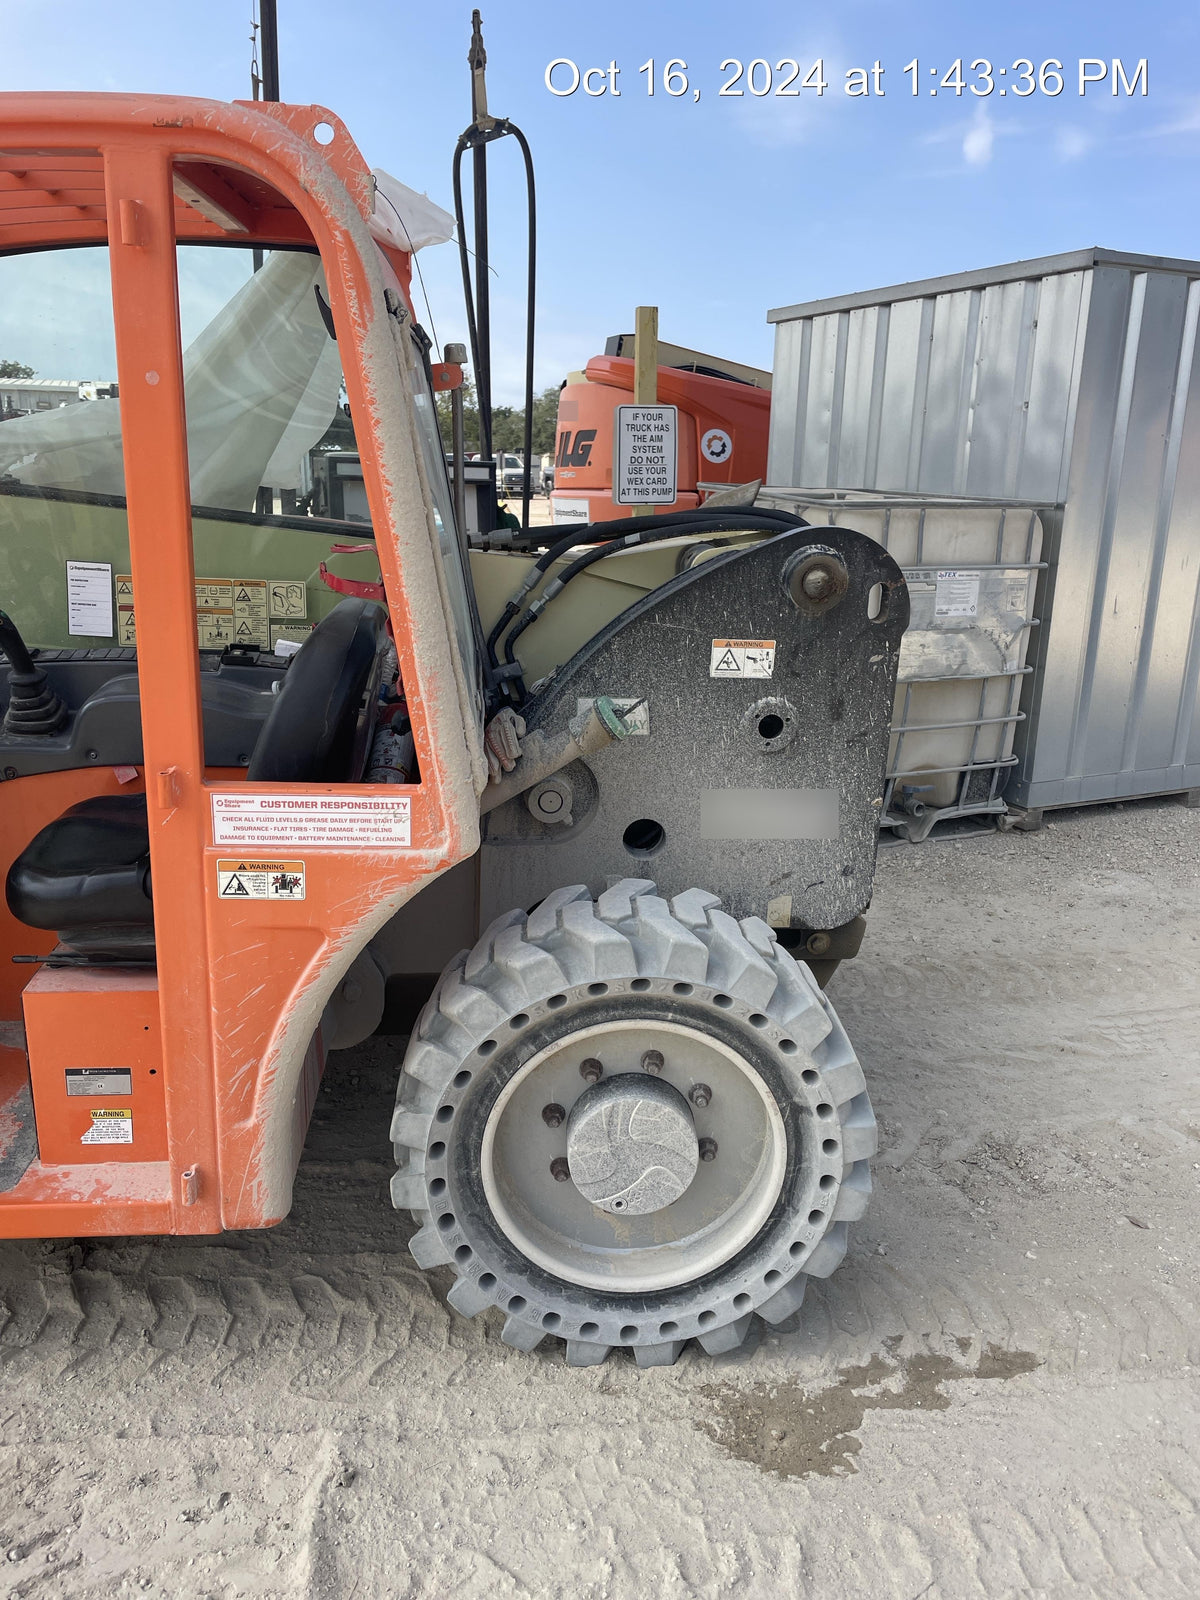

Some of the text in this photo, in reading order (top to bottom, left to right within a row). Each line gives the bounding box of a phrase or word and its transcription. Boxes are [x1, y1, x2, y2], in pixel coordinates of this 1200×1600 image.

[632, 413, 664, 421] IF YOUR
[625, 423, 670, 432] TRUCK HAS
[632, 434, 664, 442] THE AIM
[632, 445, 664, 454] SYSTEM
[630, 456, 666, 464] DO NOT
[627, 466, 667, 475] USE YOUR
[627, 477, 668, 486] WEX CARD
[620, 487, 673, 496] AT THIS PUMP
[260, 800, 318, 809] CUSTOMER
[320, 801, 408, 810] RESPONSIBILITY
